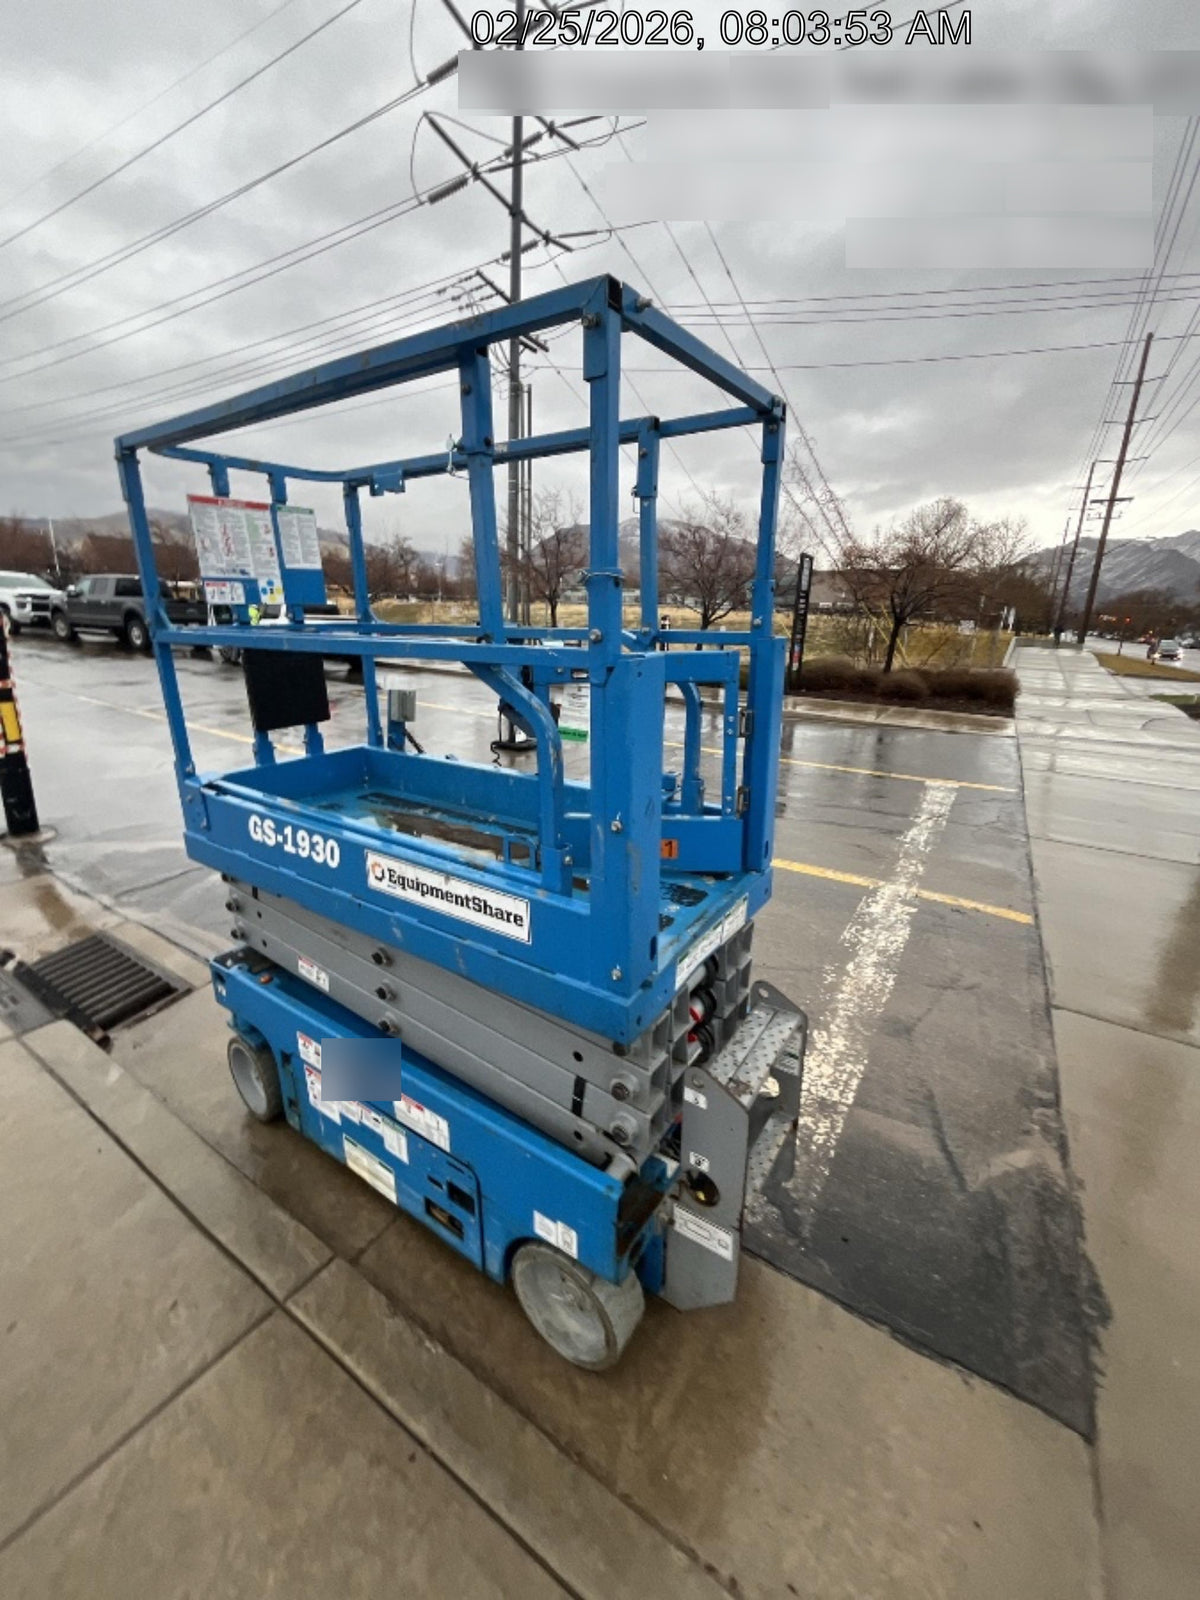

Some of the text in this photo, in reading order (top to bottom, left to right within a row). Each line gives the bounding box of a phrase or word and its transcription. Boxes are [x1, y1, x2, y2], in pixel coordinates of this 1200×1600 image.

[248, 814, 341, 869] GS-1930
[664, 840, 673, 858] 1
[387, 868, 524, 927] EquipmentShare
